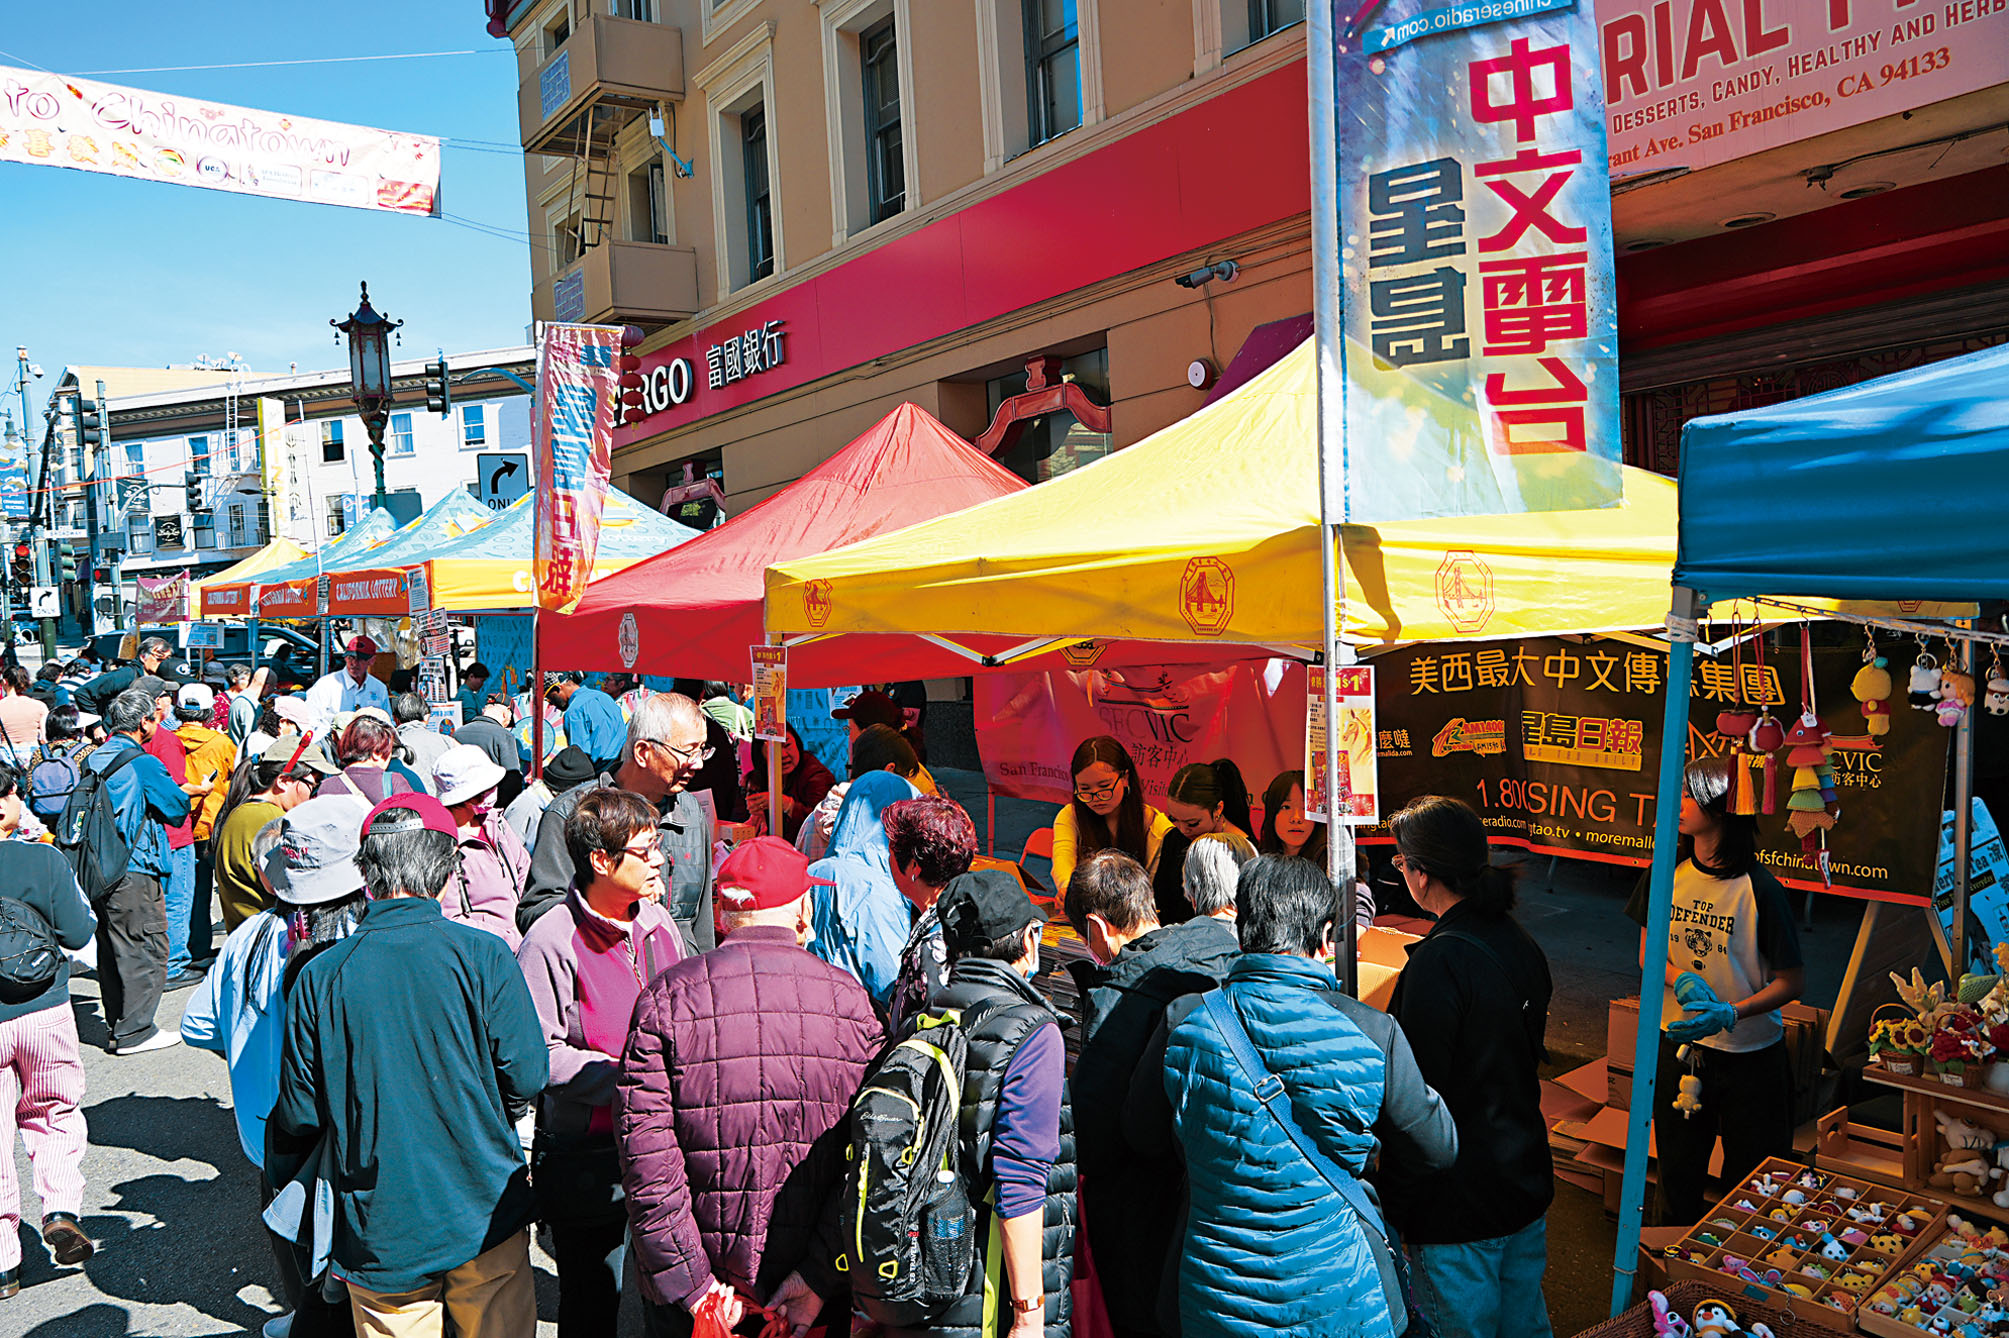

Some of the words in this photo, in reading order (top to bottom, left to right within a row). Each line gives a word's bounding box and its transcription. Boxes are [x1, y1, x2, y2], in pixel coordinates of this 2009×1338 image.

[1613, 90, 1705, 134] DESSERTS,
[1711, 65, 1781, 103] CANDY,
[1788, 30, 1881, 78] HEALTHY
[1891, 13, 1936, 46] AND
[1644, 134, 1684, 158] Ave.
[1688, 120, 1724, 145] San
[1728, 91, 1831, 134] Francisco,
[1836, 71, 1875, 98] CA
[1880, 46, 1951, 87] 94133
[91, 92, 350, 167] Chinatown
[706, 320, 788, 390] 富國銀行
[613, 357, 692, 427] RGO
[487, 497, 517, 511] ONL
[1410, 646, 1786, 706] 美西最大中文傳集團
[1376, 728, 1412, 750] 麼噠
[1000, 762, 1027, 777] San
[1480, 815, 1527, 830] eradio.com
[1670, 904, 1735, 935] DEFENDER
[1693, 899, 1714, 913] TOP
